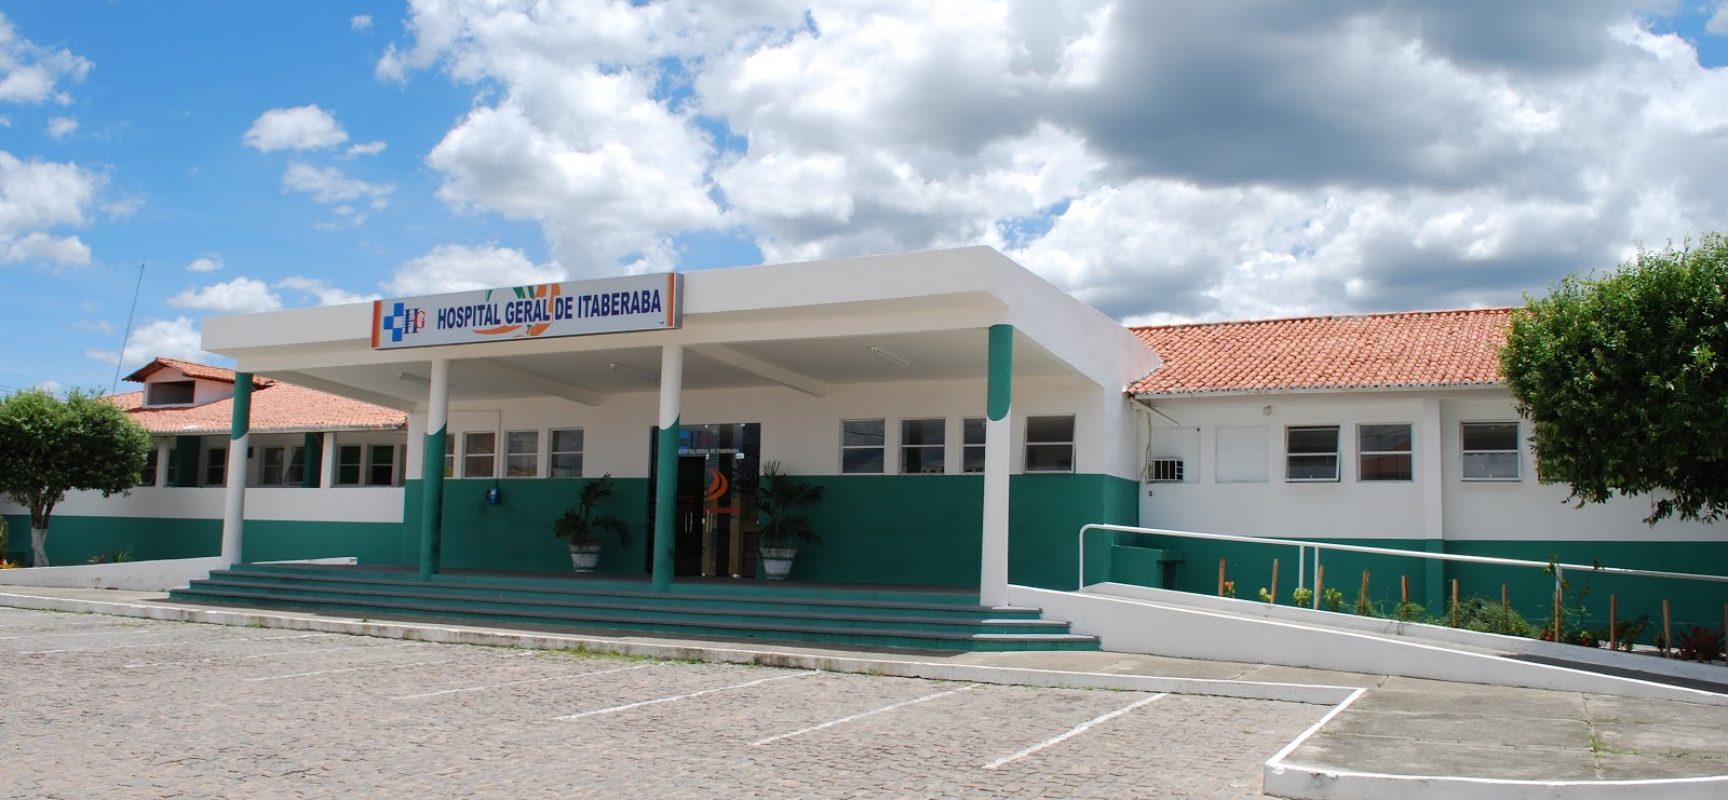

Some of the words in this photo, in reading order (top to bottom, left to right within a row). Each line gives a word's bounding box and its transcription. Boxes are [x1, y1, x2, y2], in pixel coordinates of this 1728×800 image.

[437, 304, 500, 329] HOSPITAL
[506, 298, 550, 324] GERAL
[555, 297, 573, 319] DE
[578, 289, 662, 318] ITABERABA
